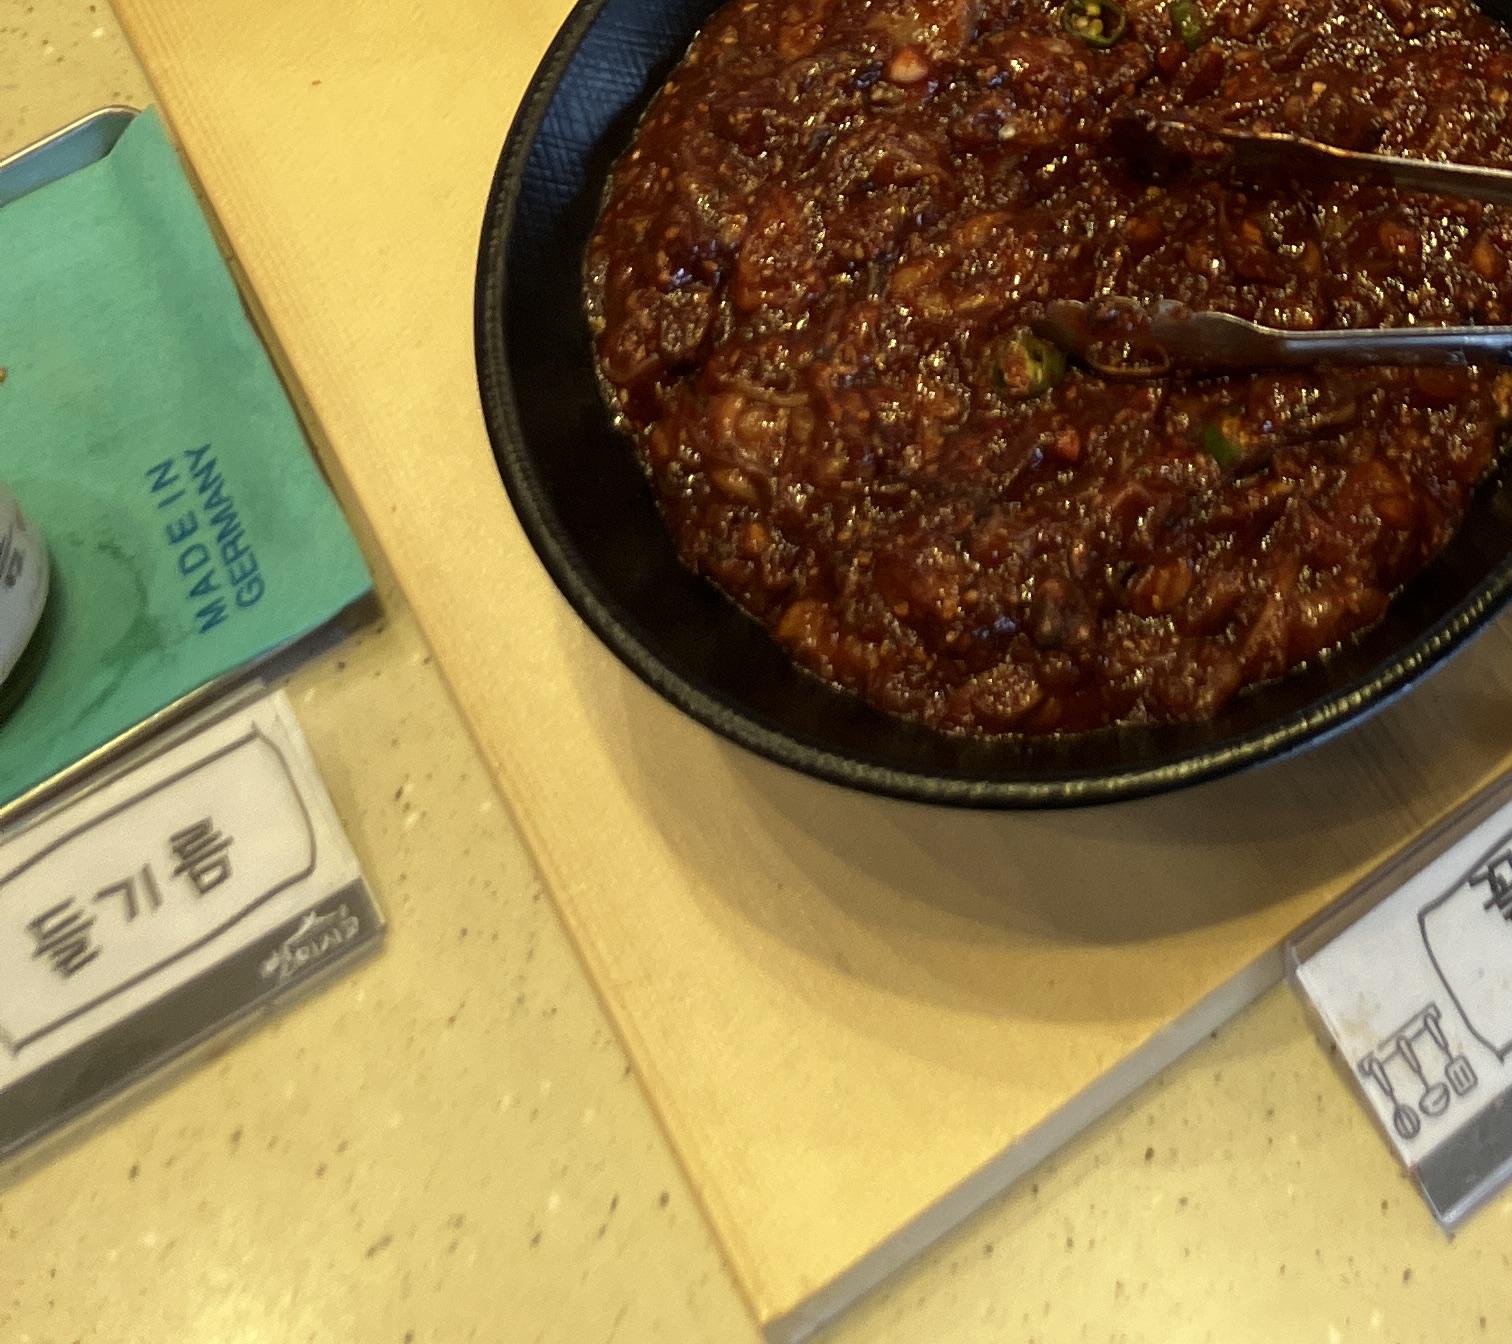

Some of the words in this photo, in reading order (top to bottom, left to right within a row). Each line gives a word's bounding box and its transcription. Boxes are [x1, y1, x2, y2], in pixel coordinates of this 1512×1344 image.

[145, 457, 184, 510] IN
[183, 443, 267, 610] GERMANY
[166, 513, 229, 634] MADE
[26, 816, 234, 979] 들기름
